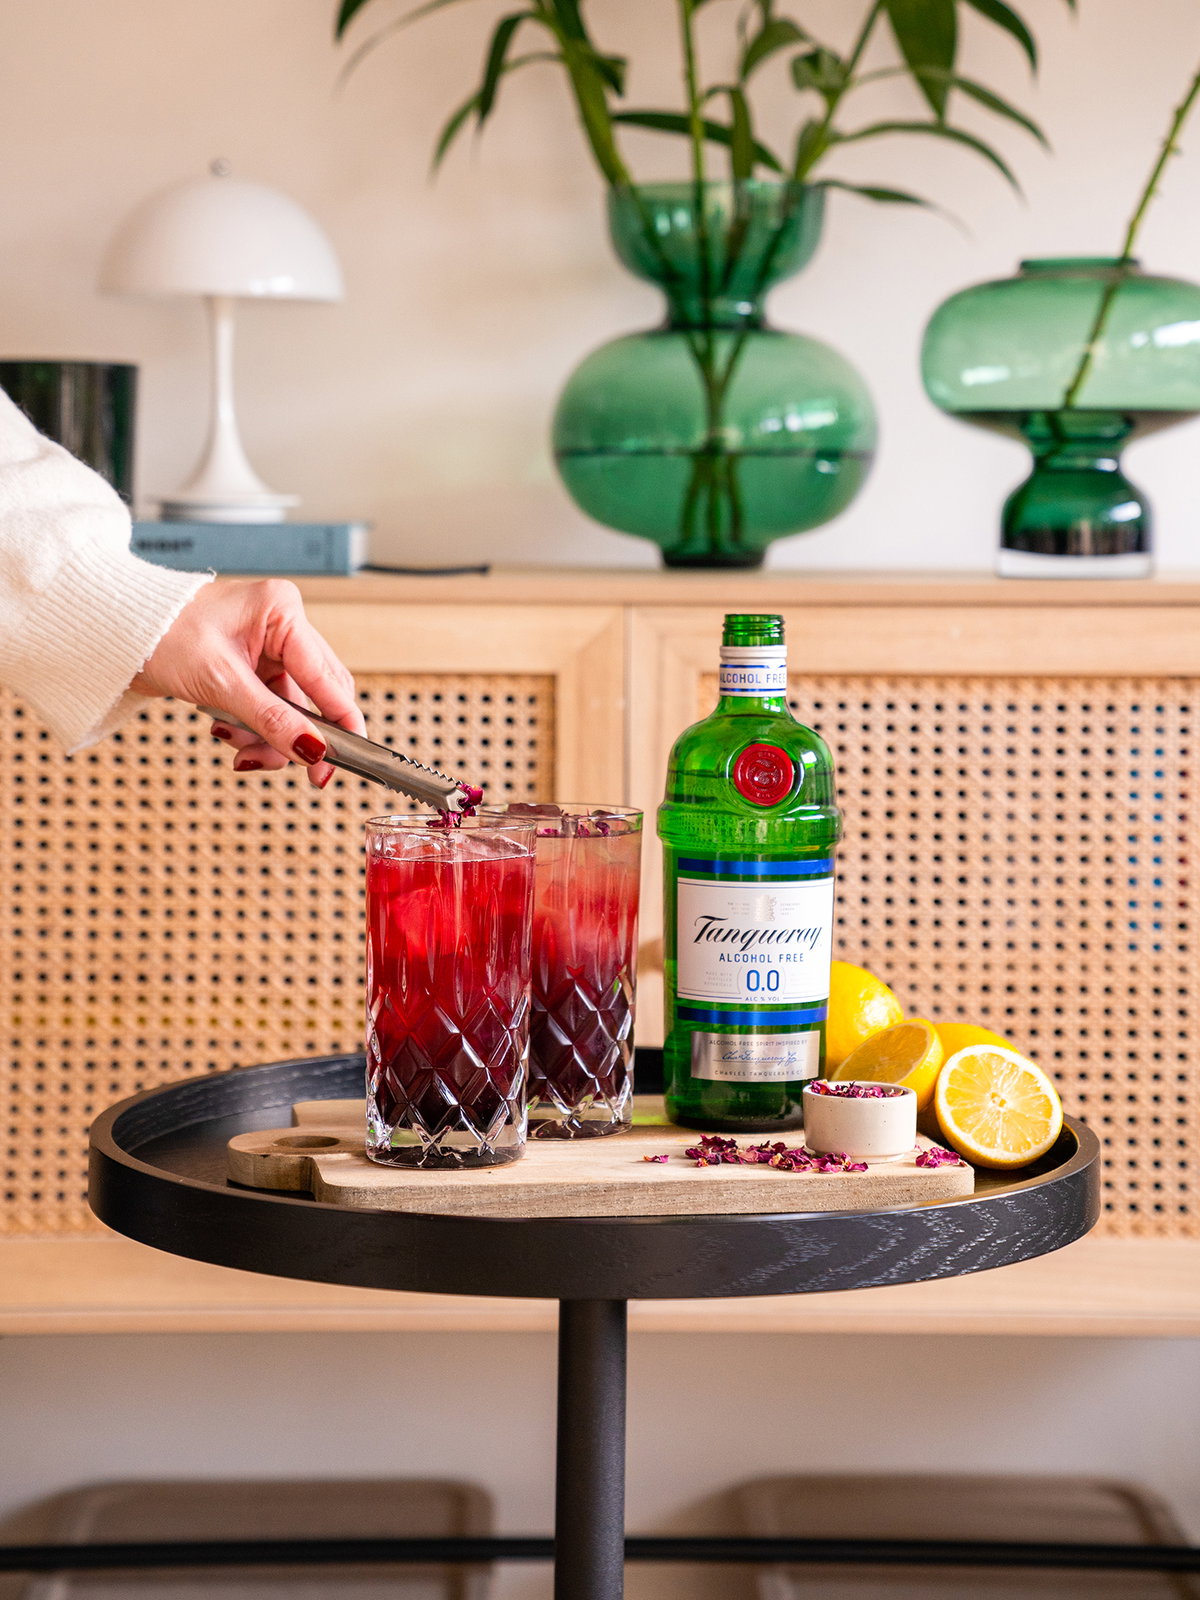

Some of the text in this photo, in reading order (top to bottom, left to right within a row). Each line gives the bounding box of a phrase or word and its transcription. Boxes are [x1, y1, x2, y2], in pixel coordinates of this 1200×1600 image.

[720, 673, 761, 684] ALCOHOL
[693, 915, 822, 952] Tanqueray
[719, 953, 804, 963] ALCOHOL FREE
[746, 969, 780, 992] 0.0
